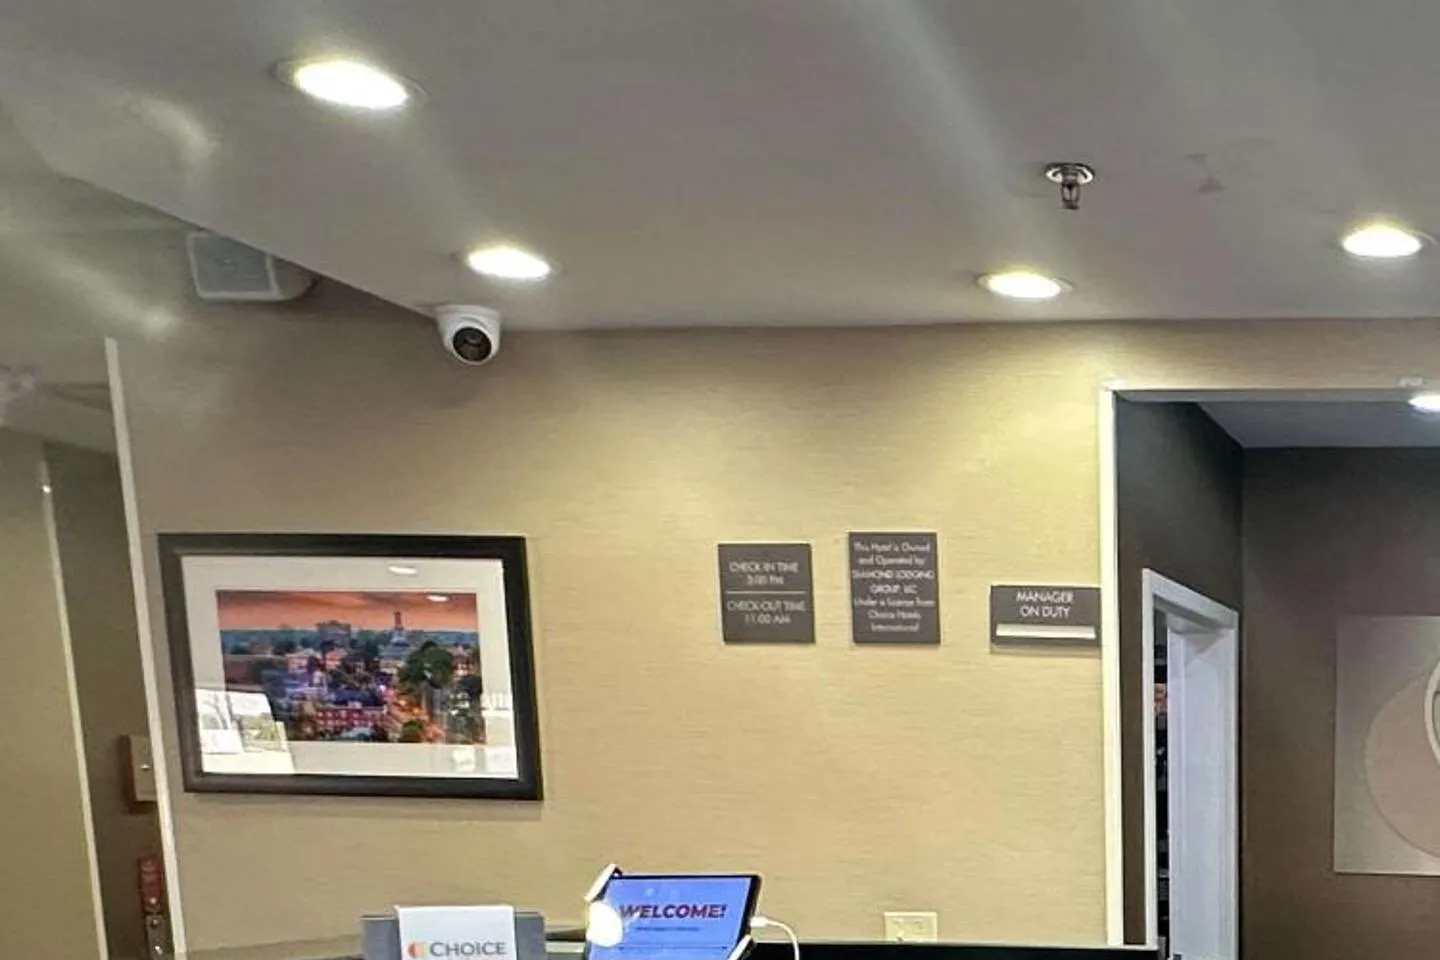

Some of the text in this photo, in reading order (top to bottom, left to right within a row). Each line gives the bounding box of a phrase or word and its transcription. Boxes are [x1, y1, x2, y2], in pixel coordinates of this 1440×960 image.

[1015, 590, 1074, 604] MANAGER
[1020, 605, 1070, 618] ON DUTY
[618, 903, 728, 920] WELCOME!
[430, 941, 508, 957] CHOICE
